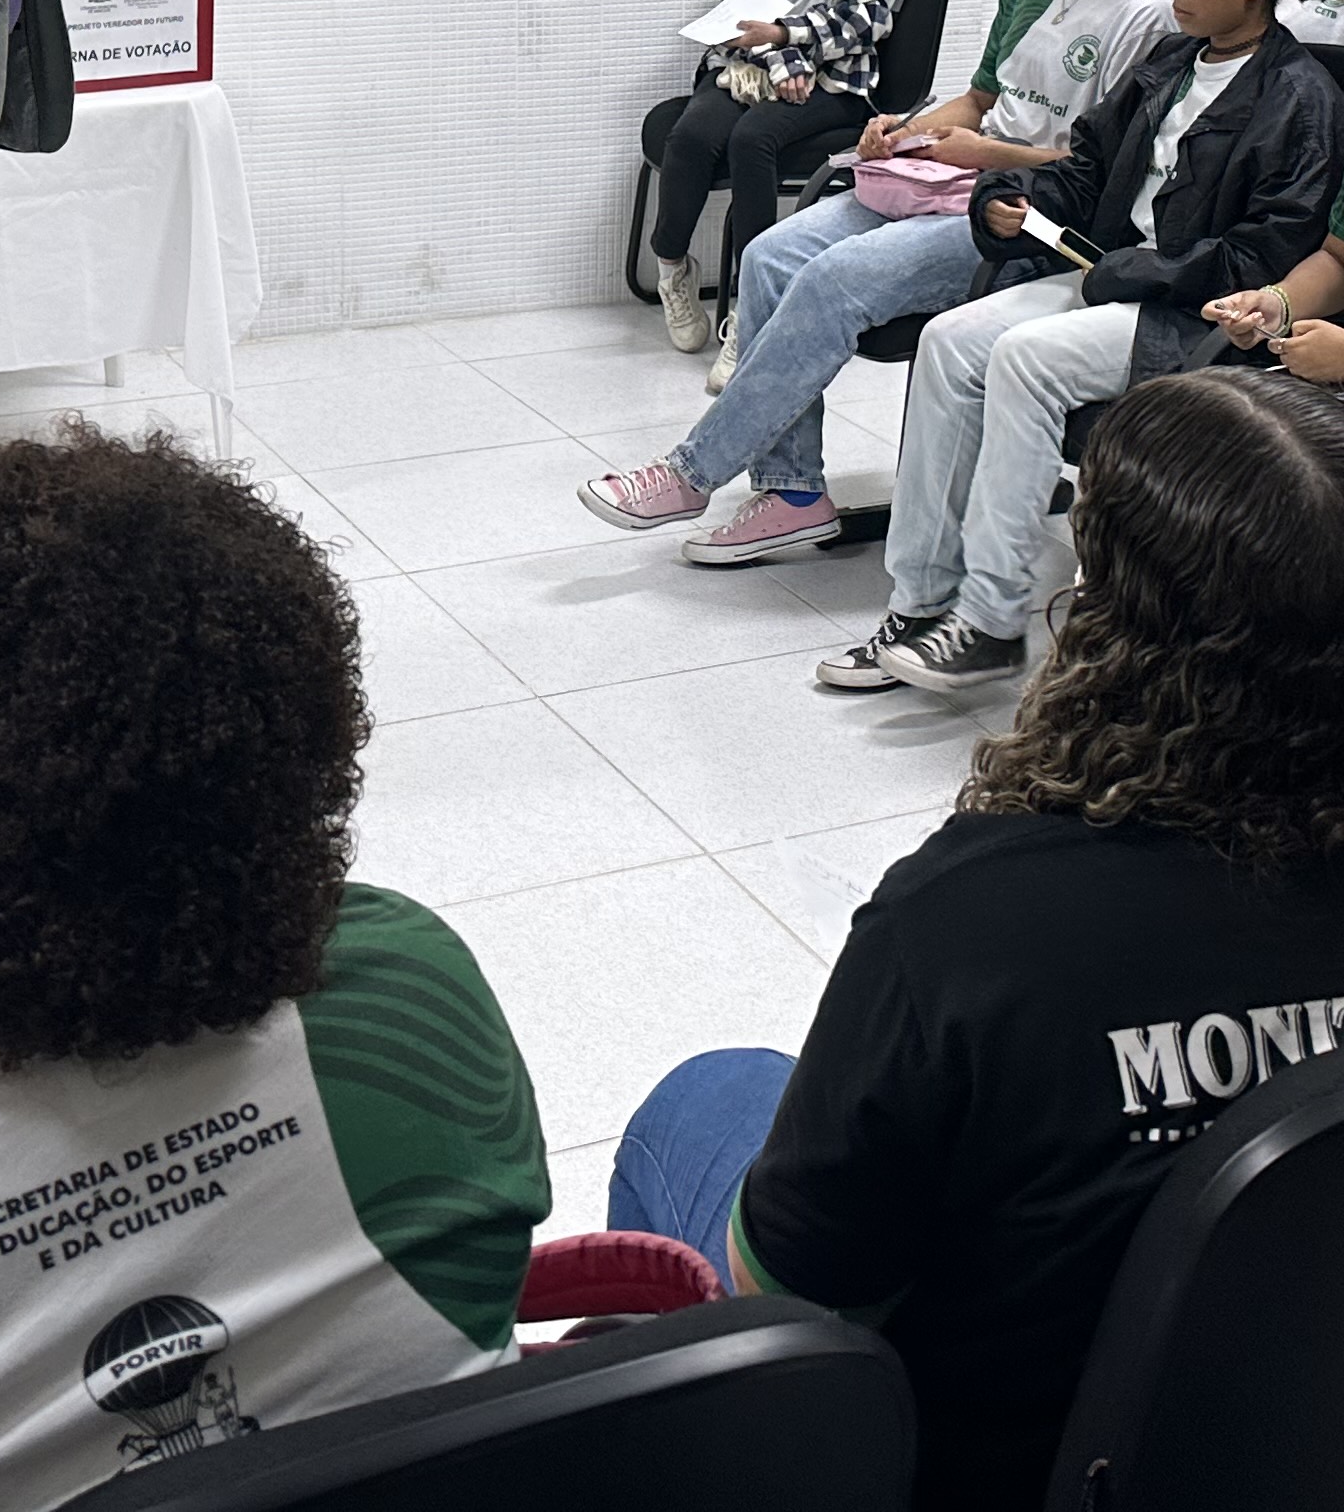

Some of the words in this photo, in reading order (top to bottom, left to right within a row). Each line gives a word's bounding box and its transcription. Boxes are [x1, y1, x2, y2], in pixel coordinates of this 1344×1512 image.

[1315, 5, 1338, 19] CETB
[71, 49, 99, 63] RNA
[102, 47, 122, 61] DE
[125, 40, 192, 58] VOTAÇÃO
[123, 1142, 159, 1172] DE
[163, 1103, 260, 1156] ESTADO
[146, 1164, 187, 1195] DO
[193, 1116, 301, 1175] ESPORTE
[38, 1248, 56, 1272] E
[61, 1230, 103, 1262] DA
[108, 1180, 228, 1241] CULTURA
[108, 1333, 204, 1380] PORVIR
